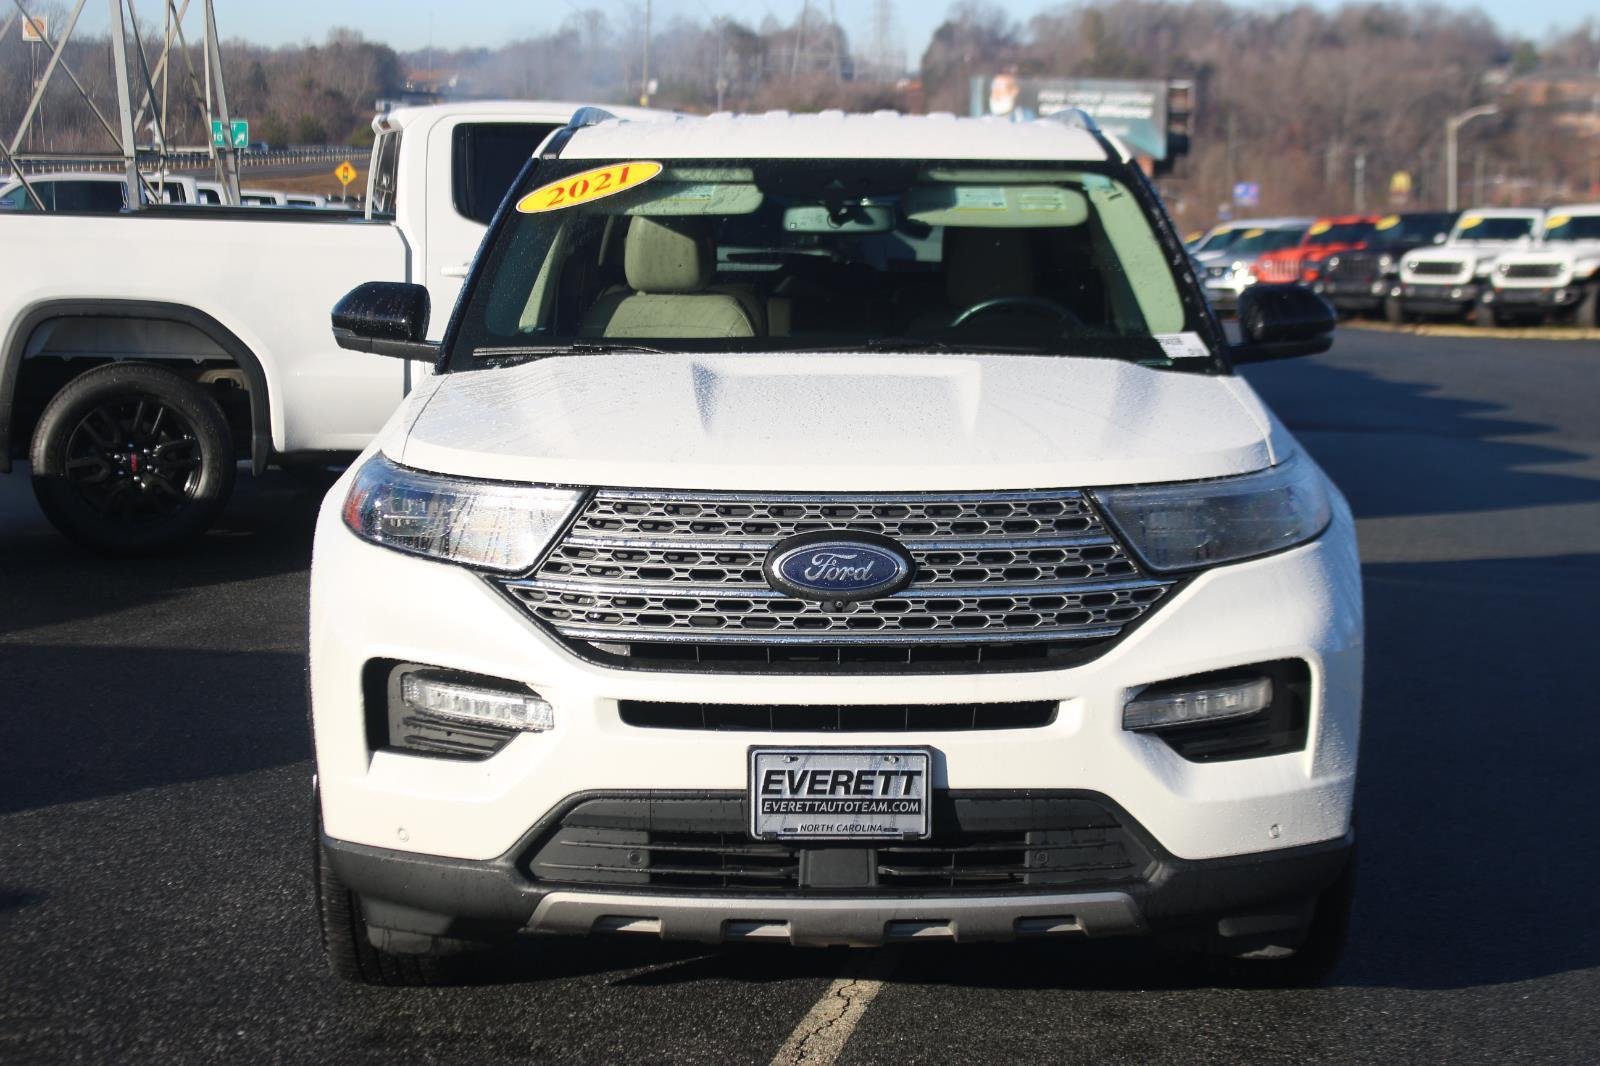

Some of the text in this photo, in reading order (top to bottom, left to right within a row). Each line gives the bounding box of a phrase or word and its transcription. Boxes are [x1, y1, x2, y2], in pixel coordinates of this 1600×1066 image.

[546, 166, 630, 207] 2021
[804, 552, 875, 581] Ford
[761, 770, 922, 796] EVERETT
[763, 801, 920, 813] EVERETTAUTOTEAM.COM
[800, 823, 883, 832] NORTH CAROLINA
